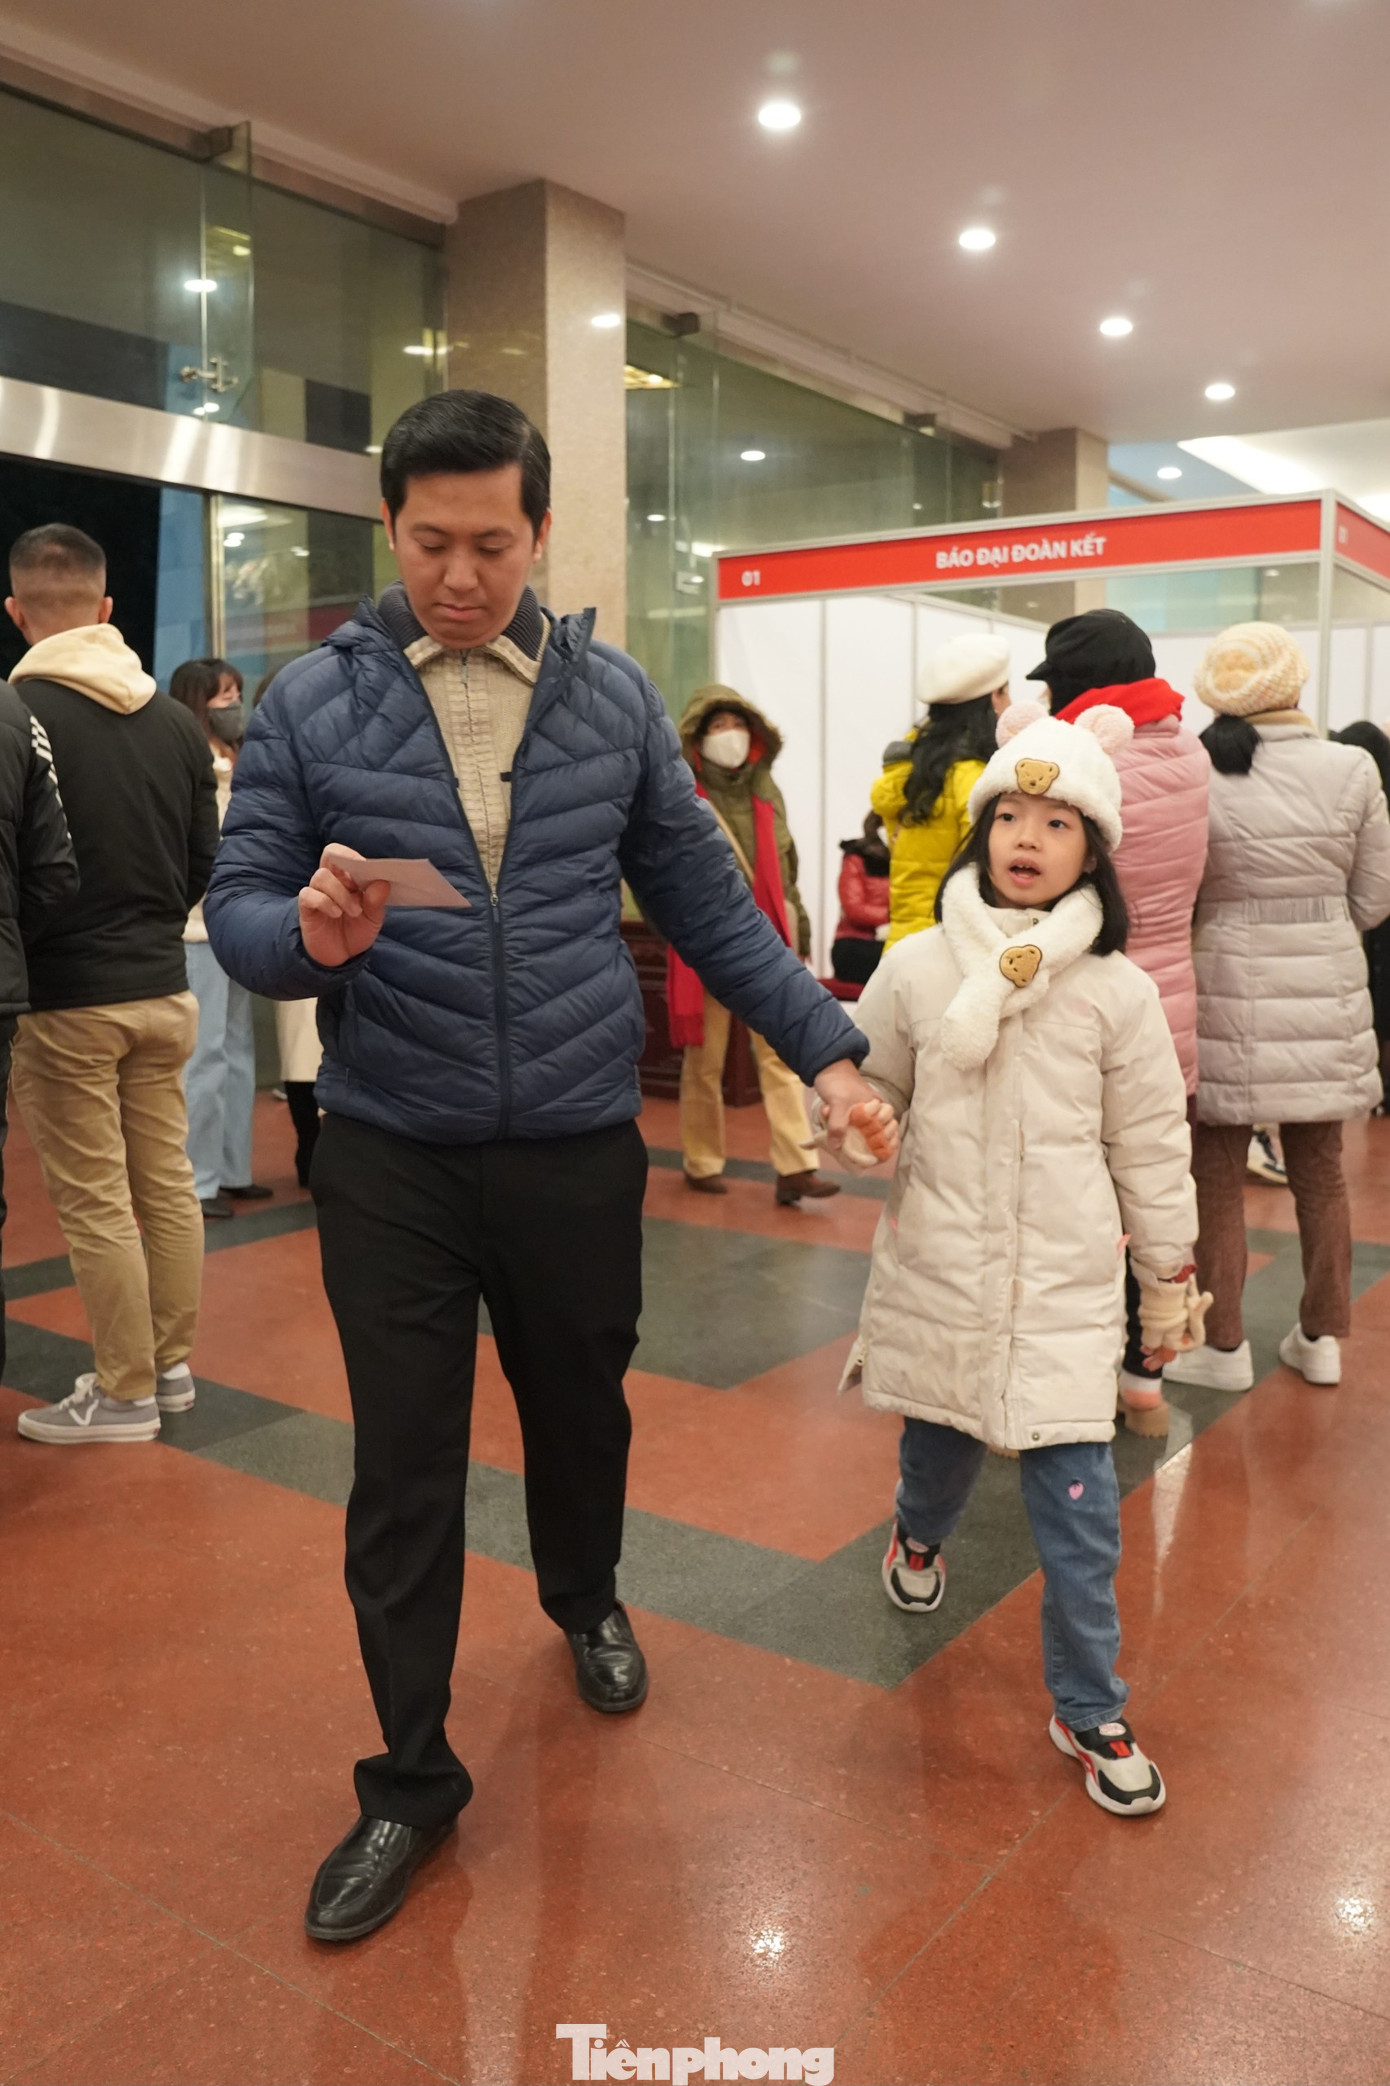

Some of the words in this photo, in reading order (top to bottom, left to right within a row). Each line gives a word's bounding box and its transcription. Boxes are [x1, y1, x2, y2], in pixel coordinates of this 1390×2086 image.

[936, 546, 974, 569] BÁO
[976, 547, 1009, 568] ĐẠI
[1011, 538, 1067, 562] ĐOÀN
[1070, 531, 1107, 557] KẾT
[741, 570, 761, 587] 01
